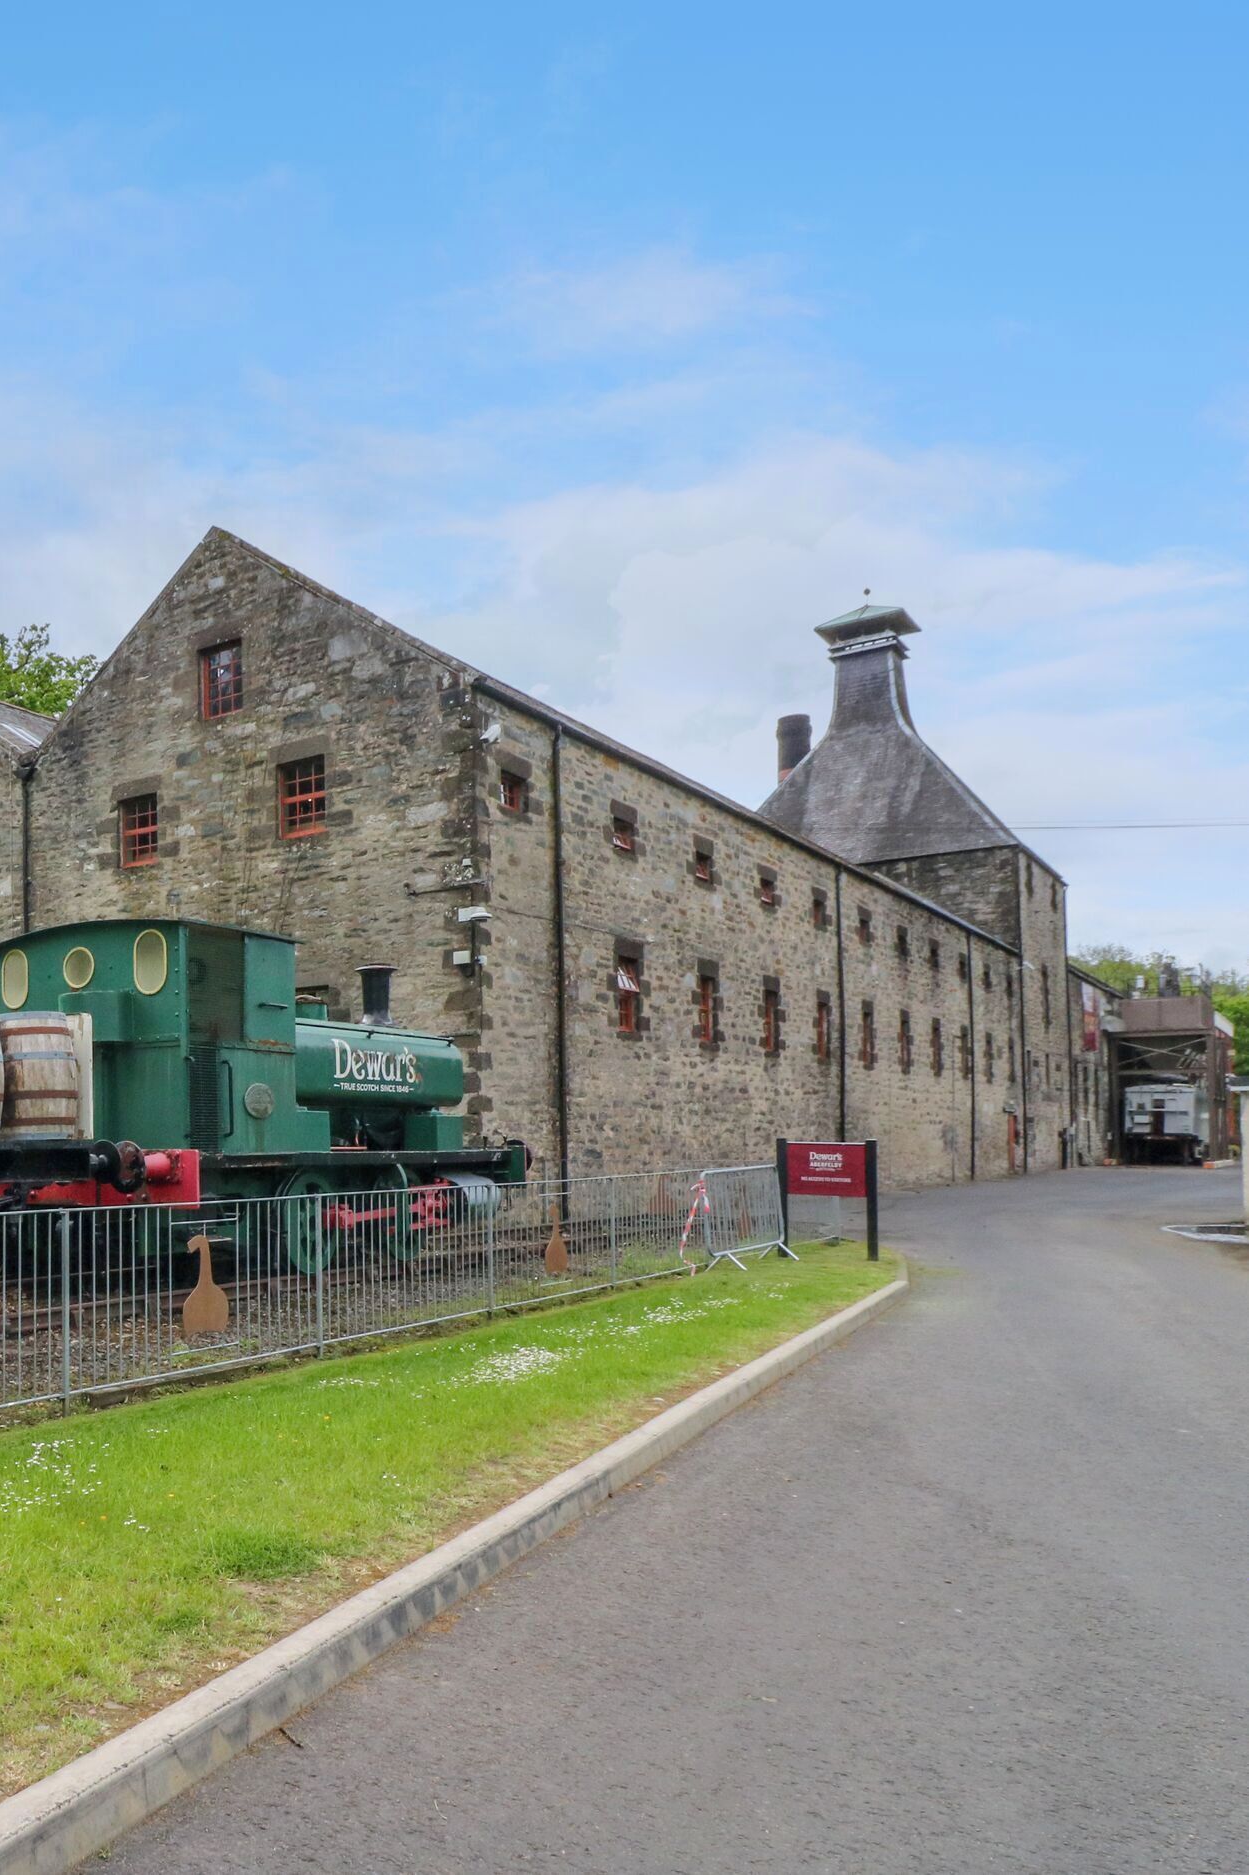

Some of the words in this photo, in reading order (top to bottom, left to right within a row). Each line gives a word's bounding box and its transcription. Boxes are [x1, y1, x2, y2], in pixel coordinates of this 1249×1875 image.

[331, 1039, 416, 1083] Dewar's
[340, 1082, 356, 1091] TRUE
[356, 1083, 379, 1092] SCOTCH
[380, 1084, 396, 1092] SINCE
[396, 1085, 409, 1093] 1846
